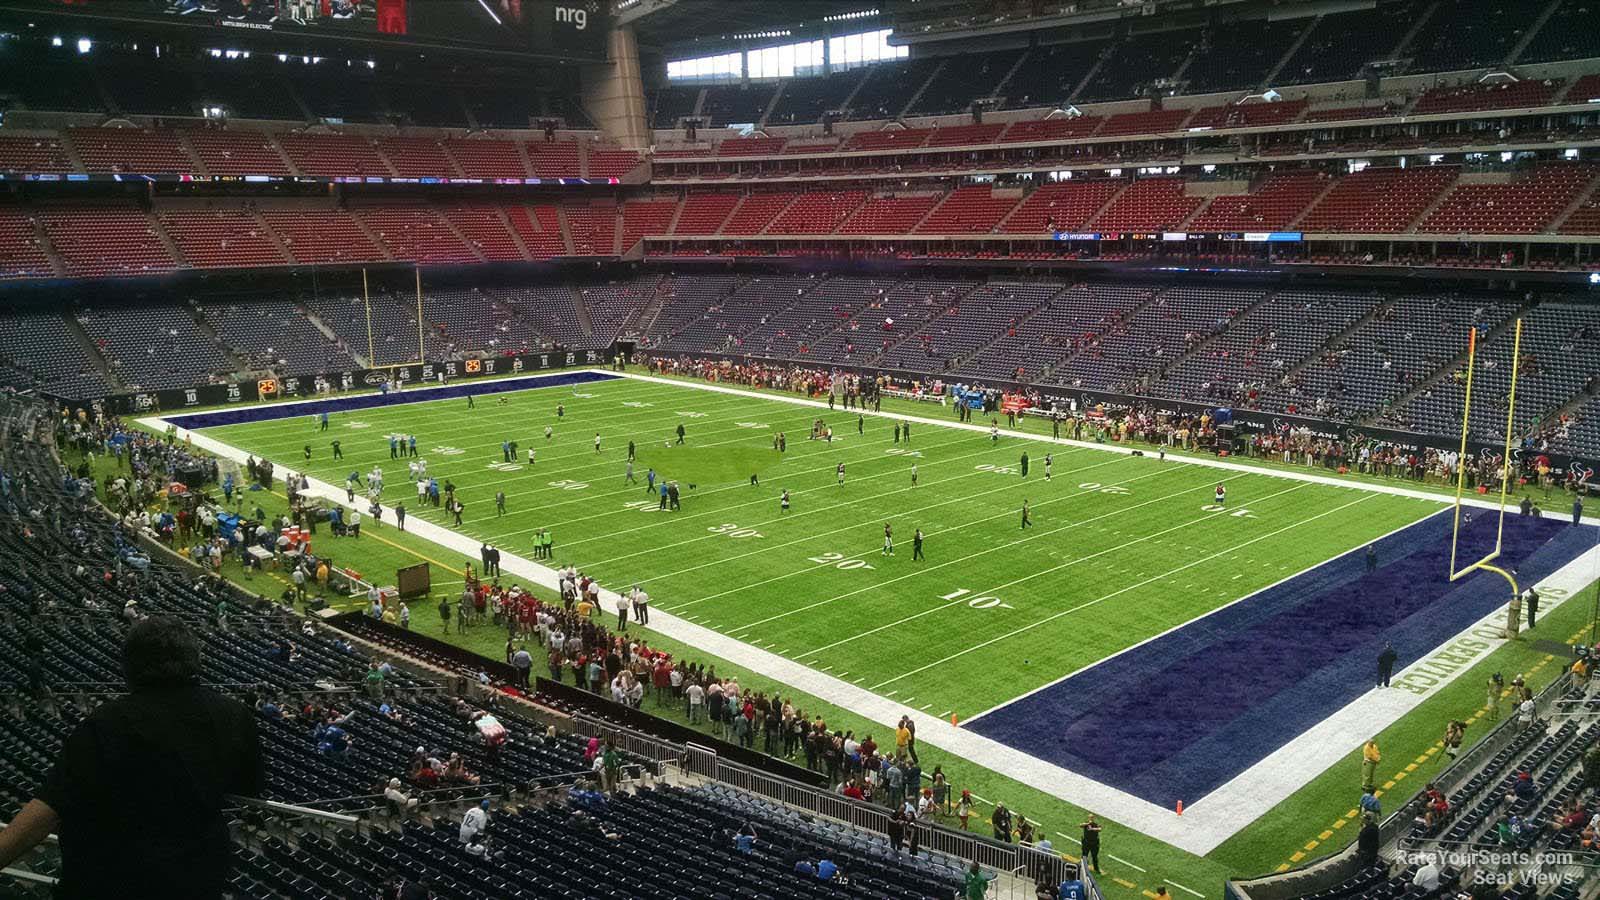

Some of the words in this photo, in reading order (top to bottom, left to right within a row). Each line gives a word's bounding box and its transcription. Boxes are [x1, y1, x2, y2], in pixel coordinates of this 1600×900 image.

[555, 6, 587, 30] nrg
[706, 523, 757, 538] 30
[808, 552, 866, 570] 20
[936, 587, 1001, 609] 10
[1390, 637, 1490, 695] SERVICE
